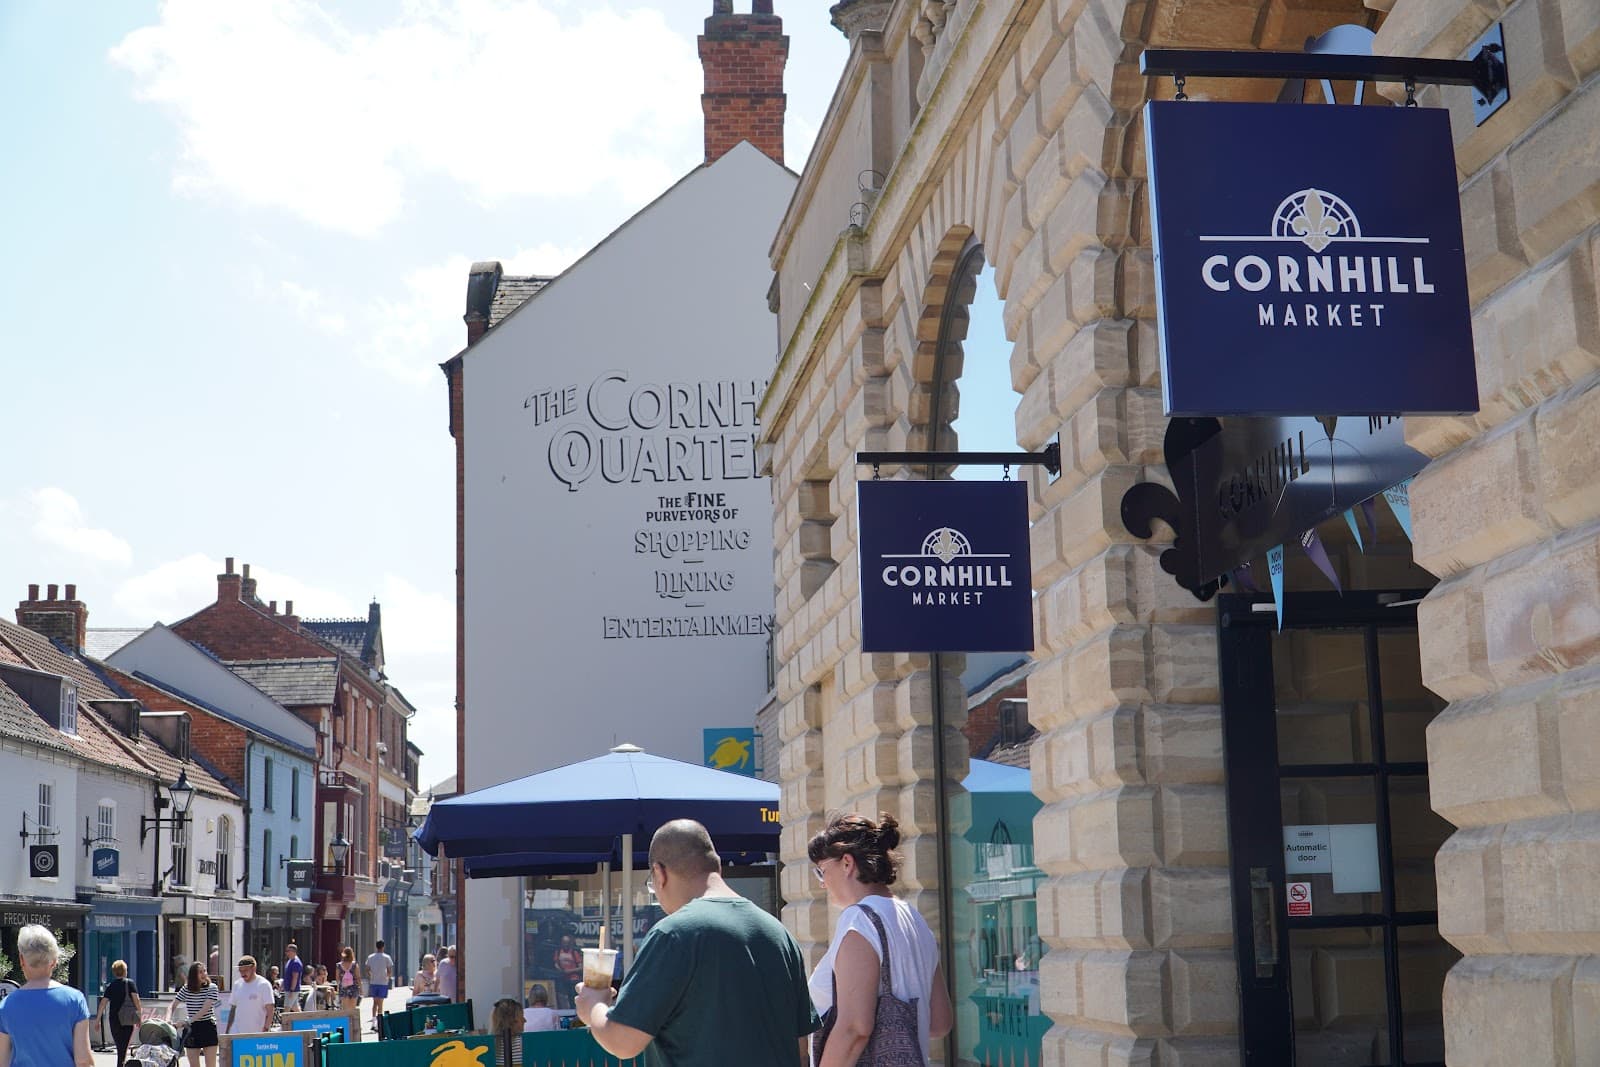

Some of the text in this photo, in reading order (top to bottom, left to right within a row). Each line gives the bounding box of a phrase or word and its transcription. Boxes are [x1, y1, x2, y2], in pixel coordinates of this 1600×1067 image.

[1201, 254, 1435, 294] CORNHILL
[1258, 303, 1385, 327] MARKET
[524, 370, 768, 431] THE CORNH
[657, 492, 727, 509] THE FINE
[646, 508, 740, 523] PURVEYORS OF
[634, 528, 751, 559] SHOPPING
[655, 569, 735, 599] DINING
[882, 565, 1013, 587] CORNHILL
[912, 591, 984, 605] MARKET
[1286, 843, 1328, 852] Automatic
[1297, 854, 1317, 862] door
[4, 911, 52, 927] FRECKLEFACE
